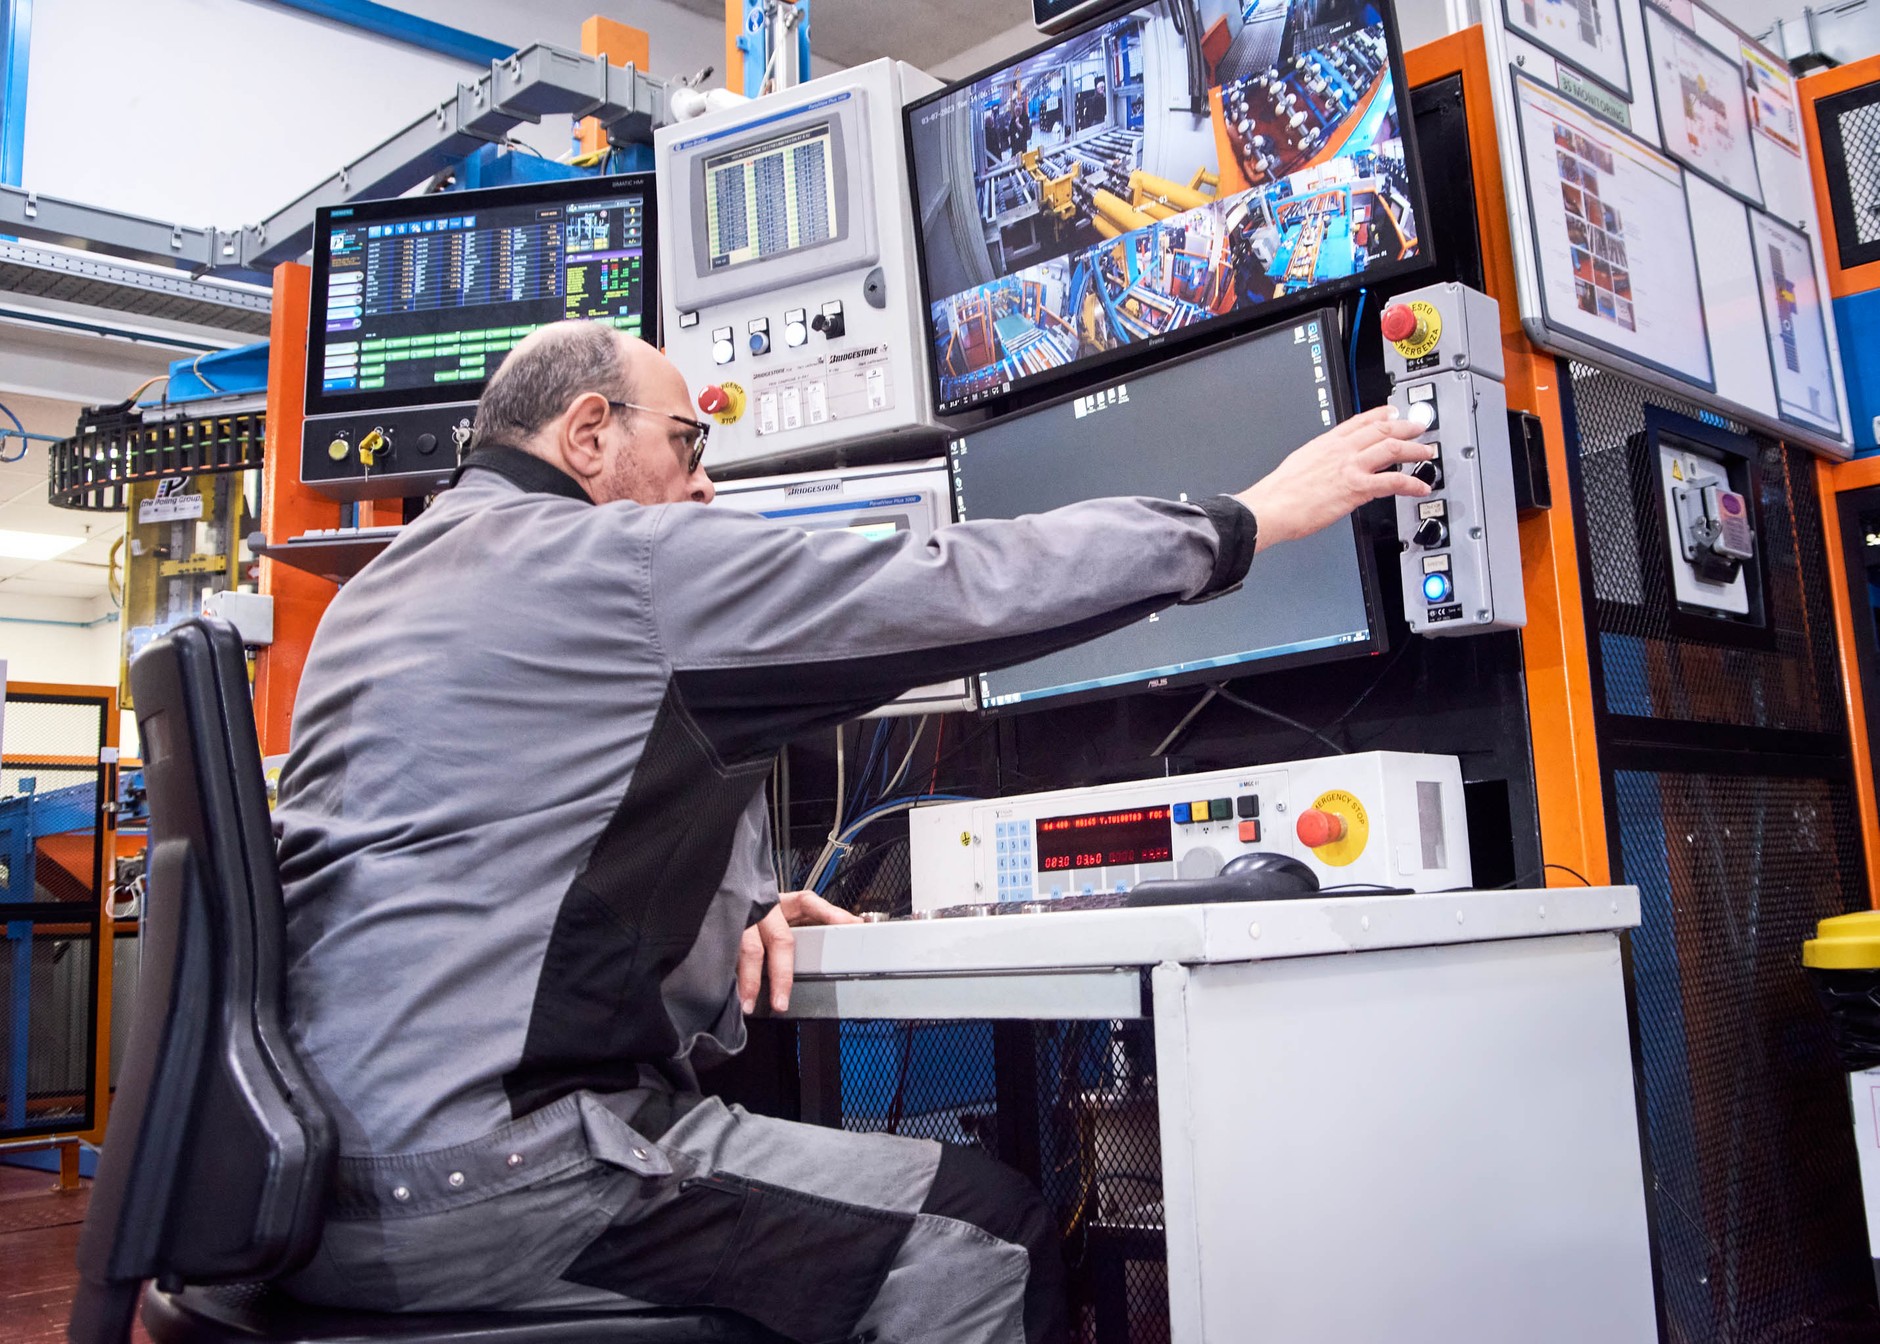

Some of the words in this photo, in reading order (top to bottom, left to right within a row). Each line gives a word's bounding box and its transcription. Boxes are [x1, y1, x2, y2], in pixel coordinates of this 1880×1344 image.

[1411, 303, 1433, 316] ESTO
[829, 347, 879, 365] BRIDGESTONE
[753, 368, 786, 380] BRIDGESTONE
[721, 415, 737, 425] STOP
[787, 482, 841, 496] BRIDGESTONE
[1148, 678, 1168, 688] ASUS
[1315, 793, 1352, 810] ERGENCY
[1351, 802, 1365, 826] STOP
